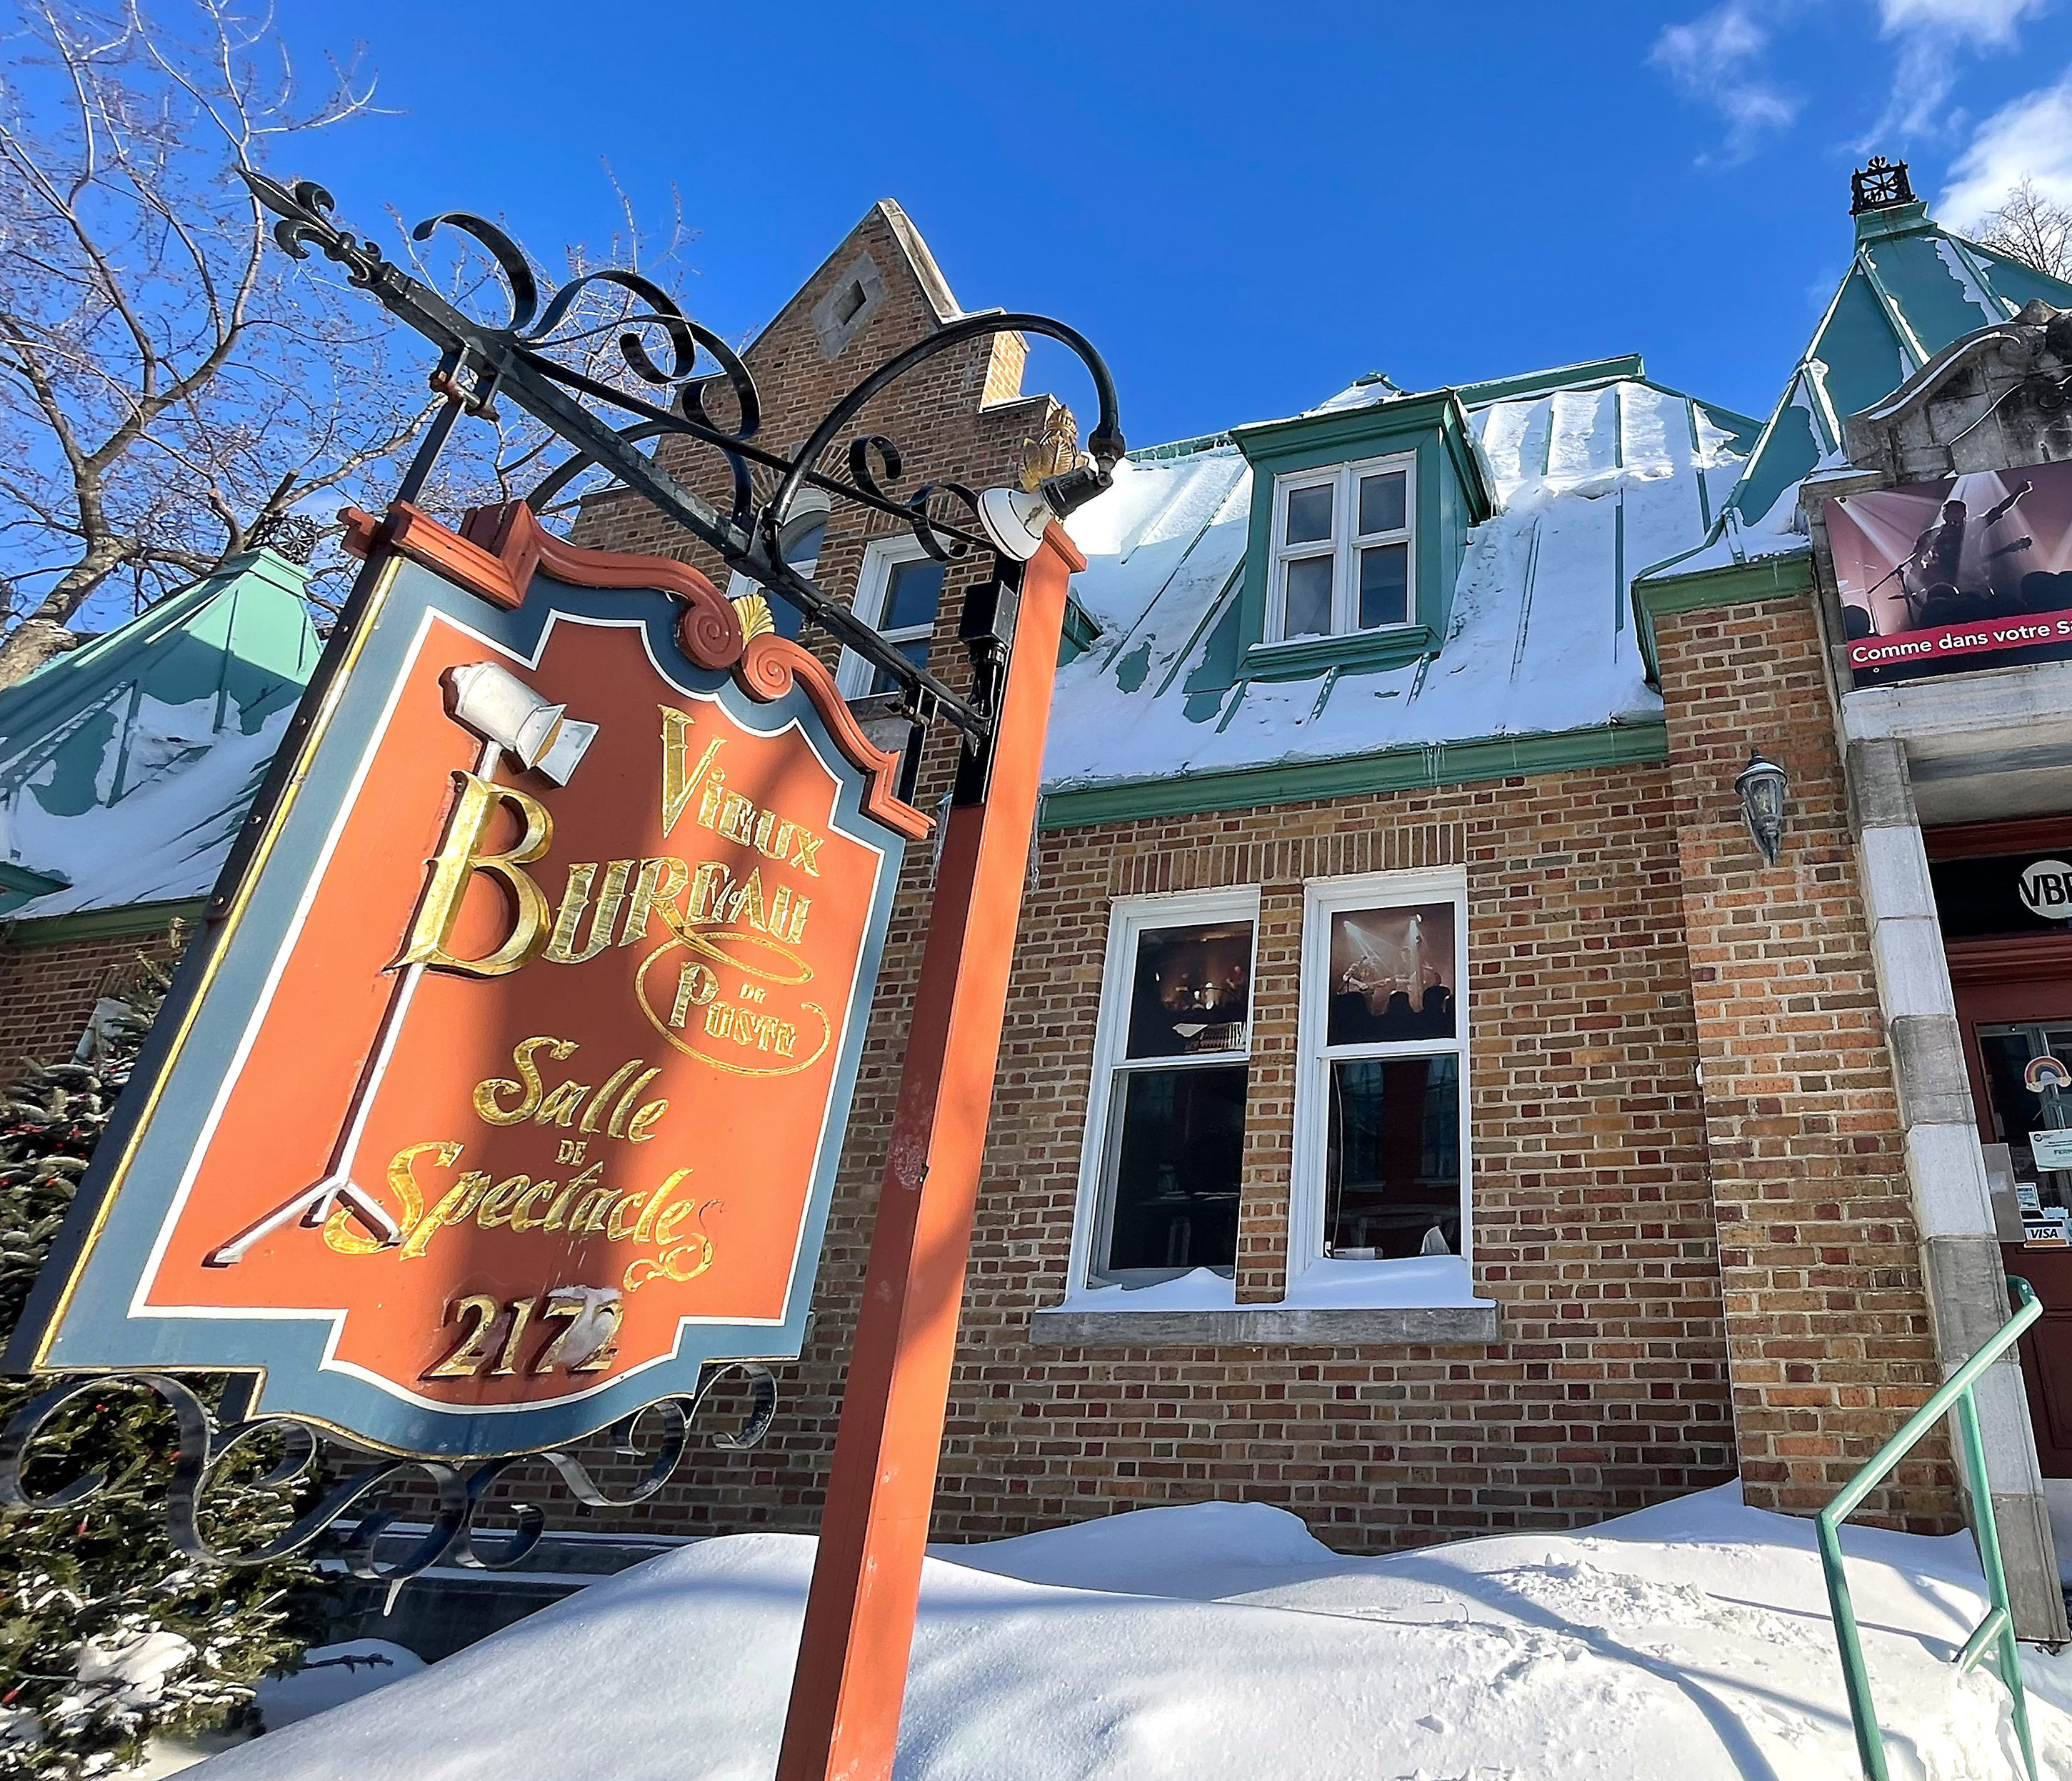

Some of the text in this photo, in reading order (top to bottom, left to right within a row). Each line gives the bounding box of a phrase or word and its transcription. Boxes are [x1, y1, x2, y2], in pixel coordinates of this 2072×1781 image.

[1852, 619, 2072, 662] Comme dans votre S
[382, 770, 813, 976] BUREAU
[668, 961, 797, 1058] POSTE
[473, 1036, 669, 1144] Salle
[554, 1139, 588, 1167] DE
[322, 1141, 726, 1292] Spectacles
[2030, 1228, 2058, 1239] VISA
